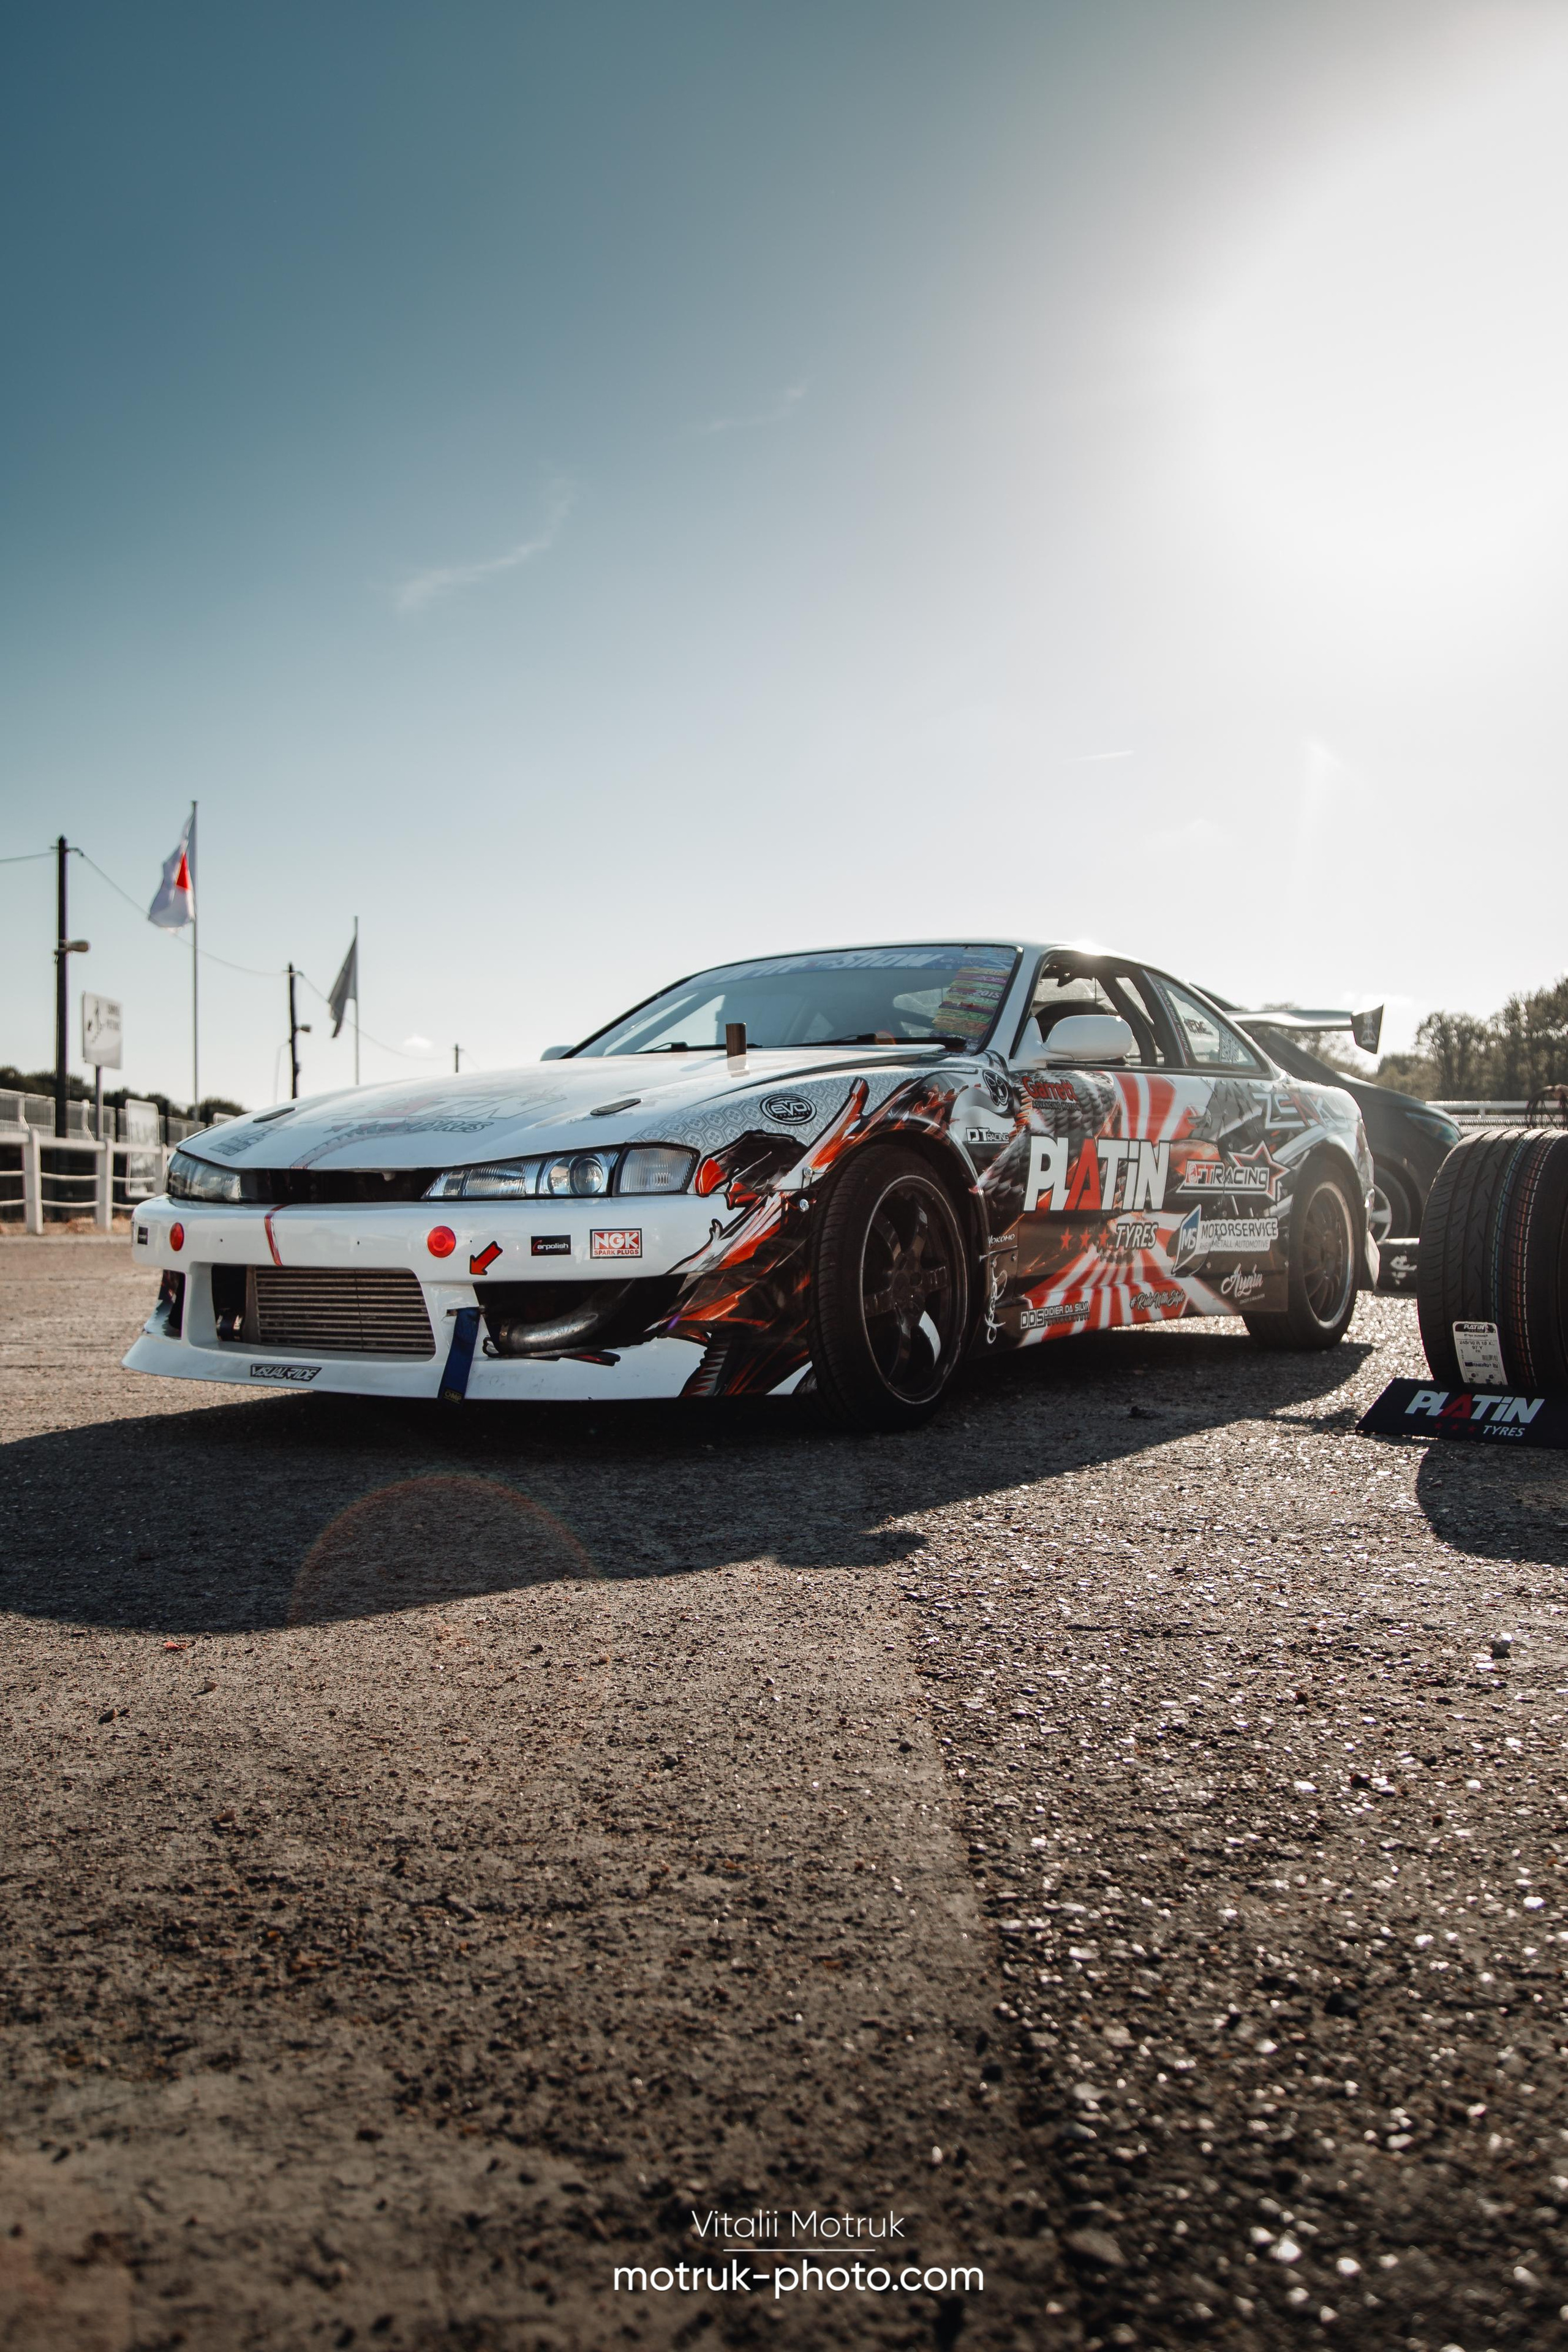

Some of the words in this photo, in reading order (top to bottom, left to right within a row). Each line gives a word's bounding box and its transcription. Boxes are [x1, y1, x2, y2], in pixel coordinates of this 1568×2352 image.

[973, 990, 1000, 998] 2015
[1022, 1076, 1078, 1101] Garrett
[771, 1100, 807, 1115] EVO
[1033, 1101, 1061, 1109] ADVANCING
[1062, 1102, 1080, 1110] MOTION
[1115, 1223, 1159, 1250] TYRES
[1201, 1221, 1278, 1239] MOTORSERVICE
[594, 1232, 638, 1249] NGK
[988, 1234, 1015, 1246] YOKOMO
[1181, 1227, 1197, 1251] MS
[1235, 1239, 1269, 1248] AUTOMOTIVE
[532, 1240, 569, 1252] Carpolish
[1044, 1305, 1064, 1317] DIDIER
[1065, 1304, 1073, 1313] DA
[1075, 1302, 1090, 1313] SILVA
[445, 1390, 462, 1401] OMP
[1482, 1425, 1525, 1437] TYRES
